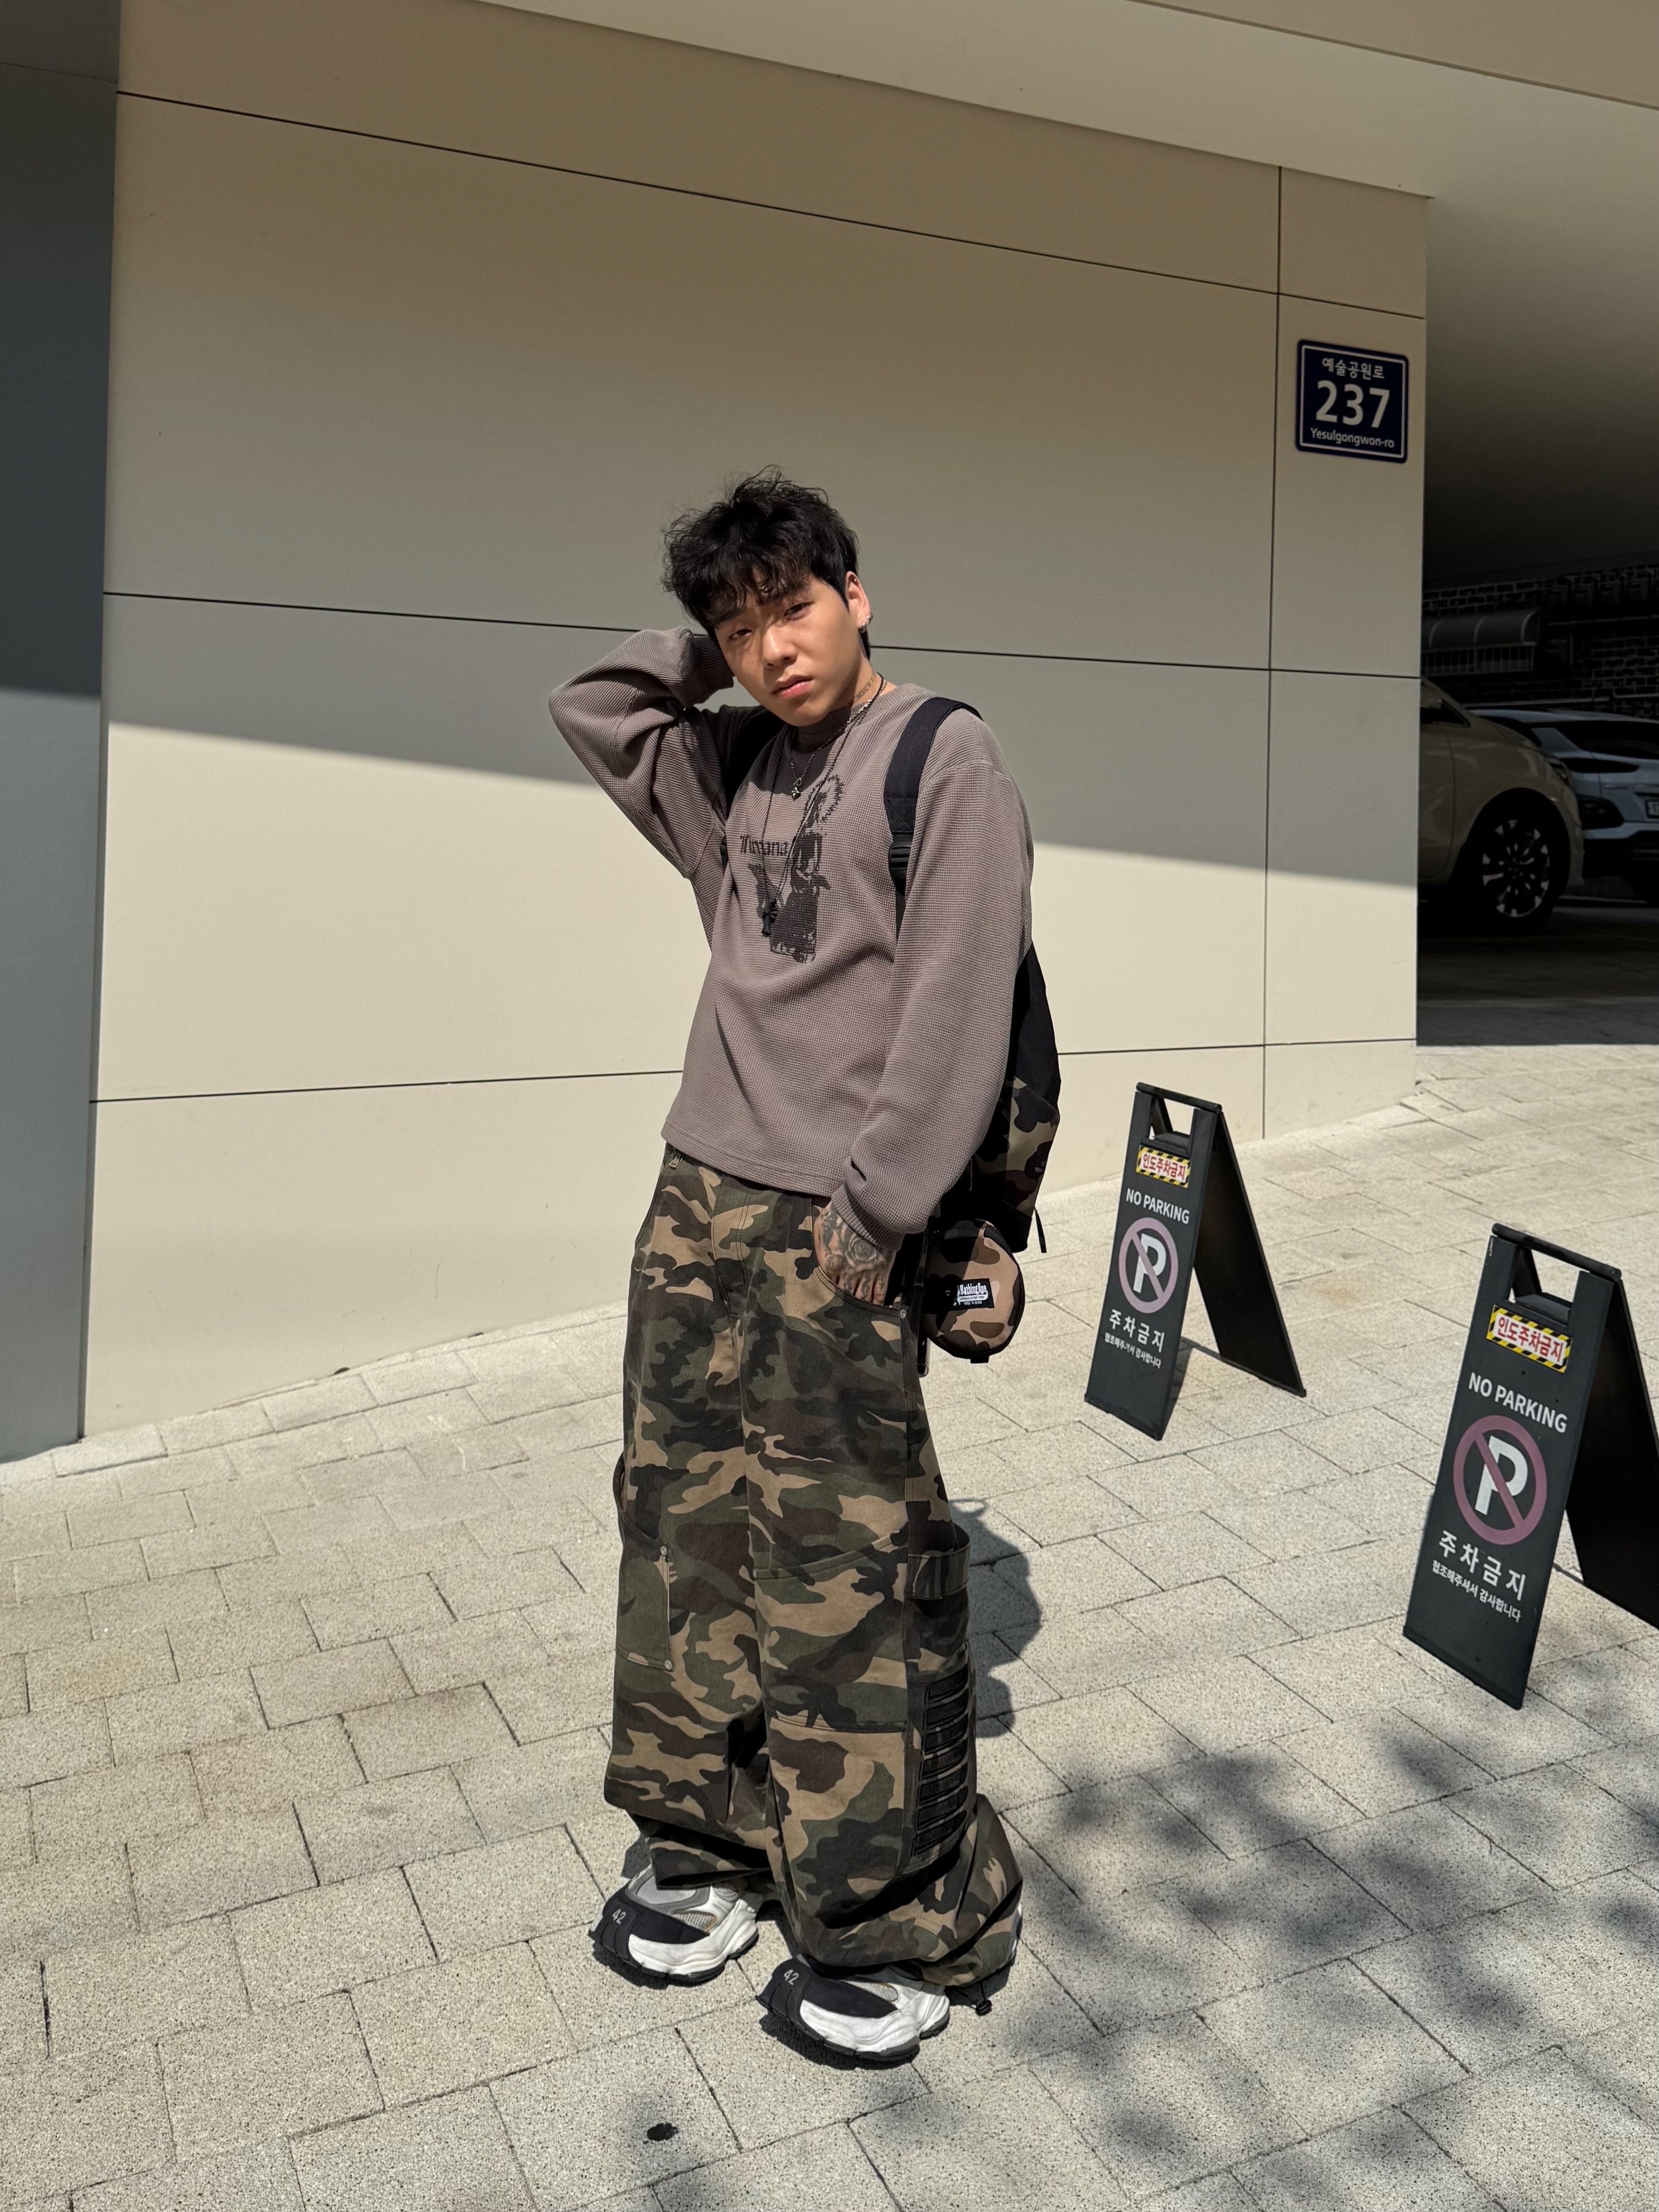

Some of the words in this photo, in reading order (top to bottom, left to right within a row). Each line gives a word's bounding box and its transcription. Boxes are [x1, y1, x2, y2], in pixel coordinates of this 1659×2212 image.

[1322, 358, 1384, 380] 예술공원로
[1315, 380, 1390, 428] 237
[1310, 427, 1395, 448] Yesulgongwon-ro
[1142, 1153, 1186, 1181] 인도주차금지
[1126, 1188, 1142, 1205] NO
[1143, 1194, 1190, 1224] PARKING
[1109, 1309, 1165, 1352] 주차금지
[1496, 1317, 1564, 1363] 인도주차금지
[1468, 1372, 1493, 1397] NO
[1494, 1384, 1568, 1433] PARKING
[1439, 1530, 1526, 1601] 주차금지
[1432, 1560, 1479, 1598] 협조해주셔서
[1480, 1588, 1521, 1623] 감사합니다
[612, 1908, 626, 1925] 42
[784, 1969, 799, 1986] 42
